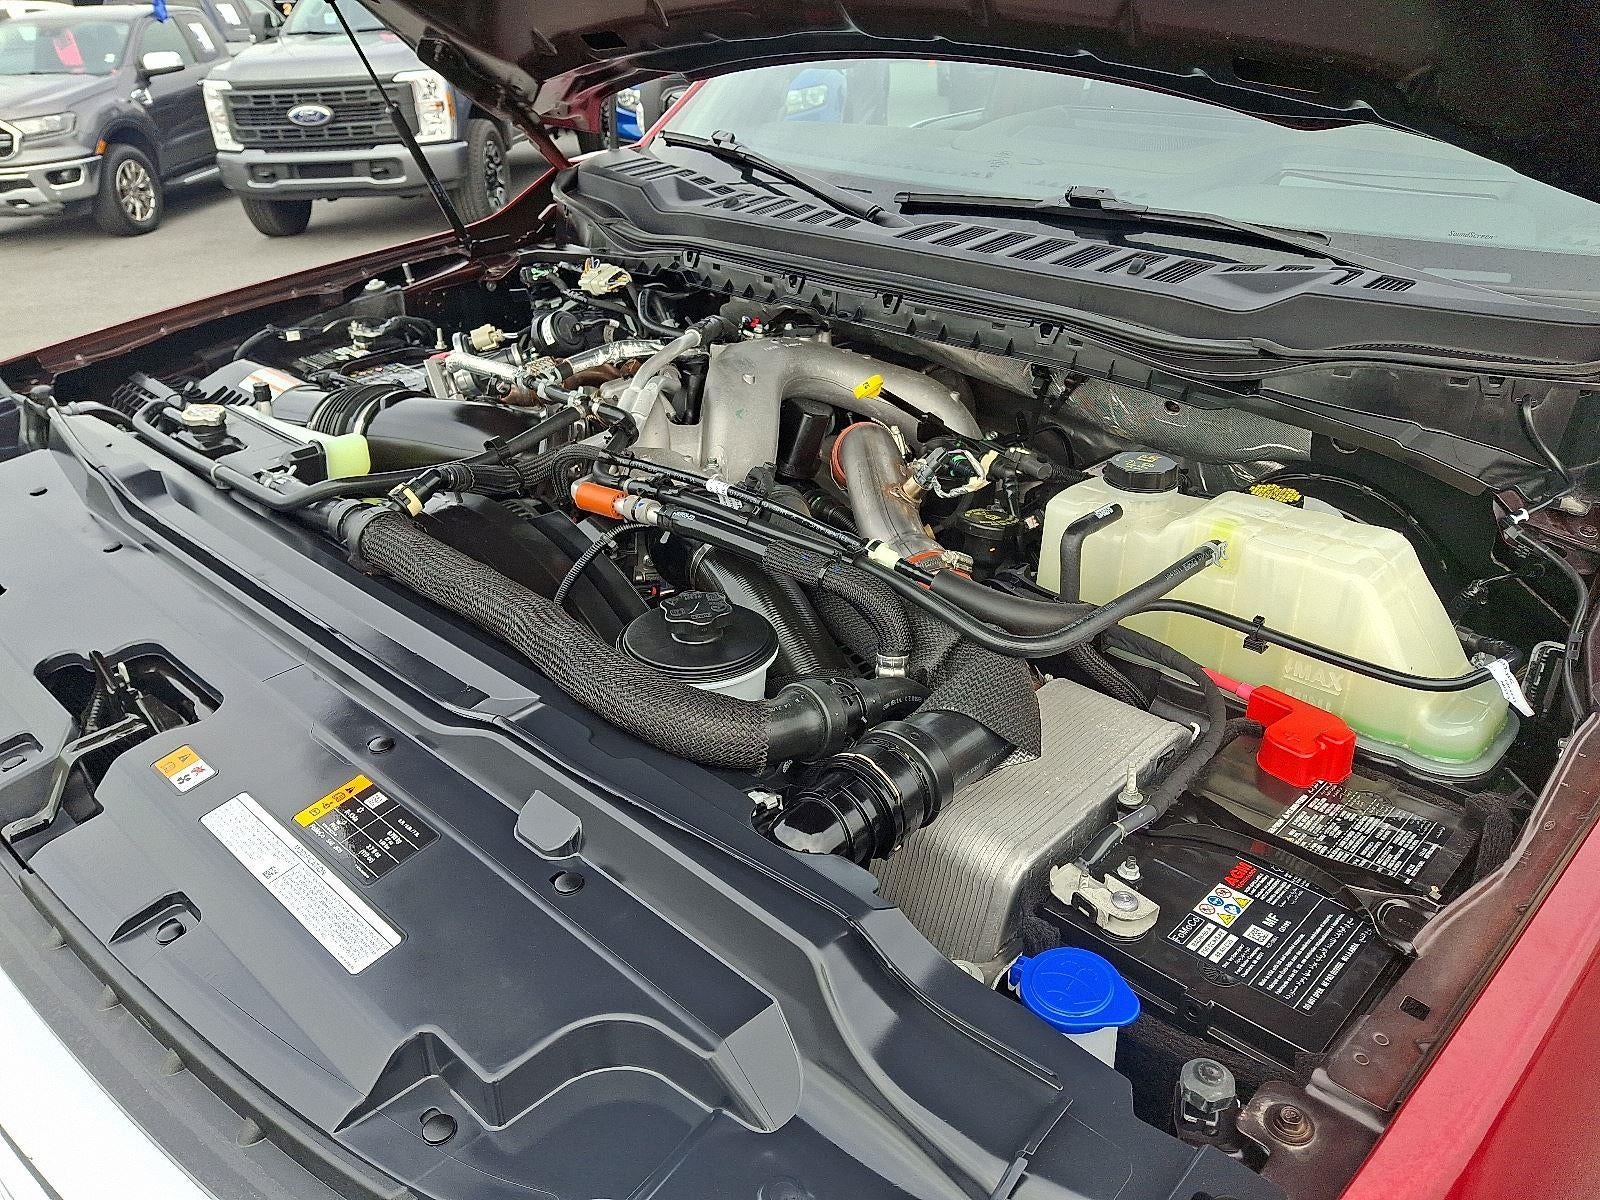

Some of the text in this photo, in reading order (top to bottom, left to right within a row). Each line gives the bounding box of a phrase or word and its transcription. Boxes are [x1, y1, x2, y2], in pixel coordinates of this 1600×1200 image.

[1293, 660, 1344, 692] MAX
[1223, 860, 1254, 886] AGM
[1171, 916, 1201, 943] FoMoCo
[1261, 912, 1280, 928] MF
